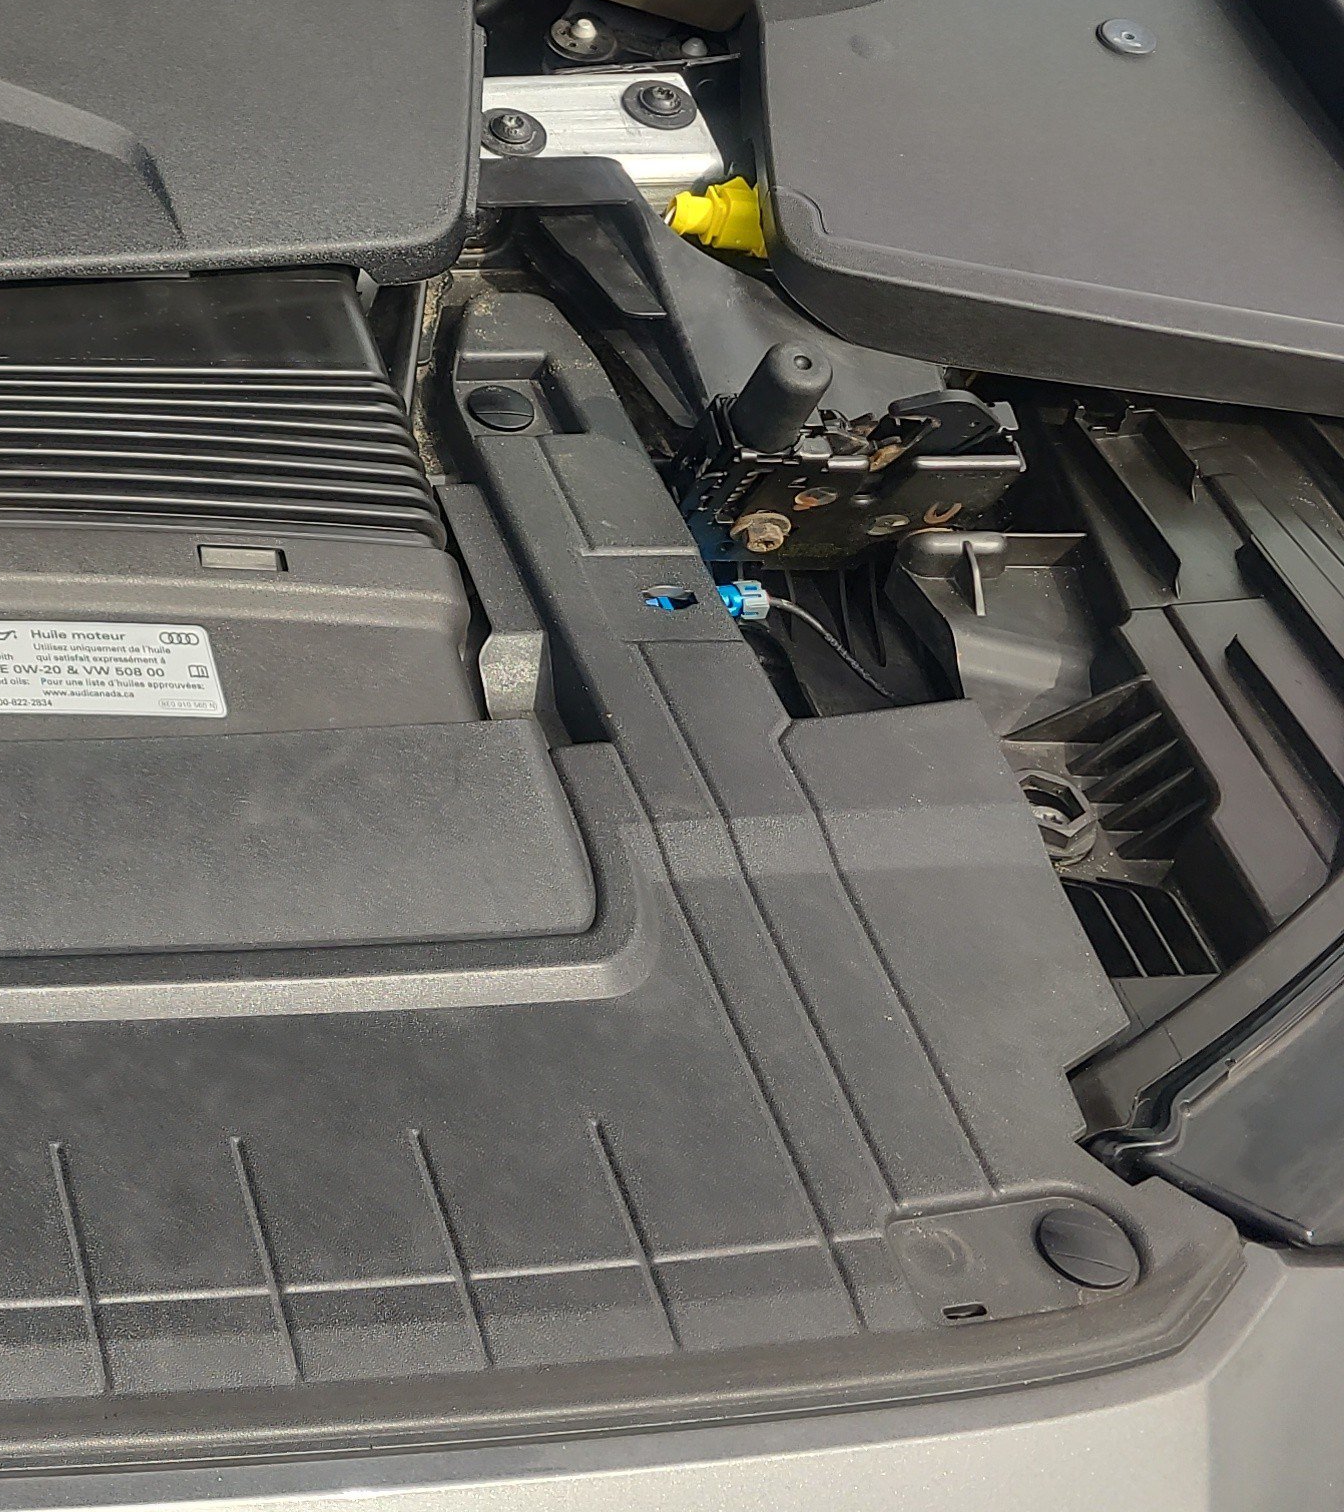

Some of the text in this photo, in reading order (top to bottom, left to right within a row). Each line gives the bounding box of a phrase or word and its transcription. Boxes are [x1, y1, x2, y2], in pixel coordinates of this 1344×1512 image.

[30, 629, 126, 640] Huile moteur
[33, 643, 68, 651] Utilisez
[69, 644, 126, 654] uniquement
[127, 645, 140, 653] de
[36, 654, 51, 662] qui
[53, 654, 90, 662] satisfait
[12, 664, 61, 674] 0W-20
[66, 665, 78, 675] &
[83, 665, 110, 675] VW
[114, 666, 142, 676] 508
[146, 667, 165, 676] 00
[9, 677, 30, 685] oils:
[40, 678, 62, 686] Pour
[84, 678, 105, 687] liste
[42, 688, 134, 698] www.audicanada.ca
